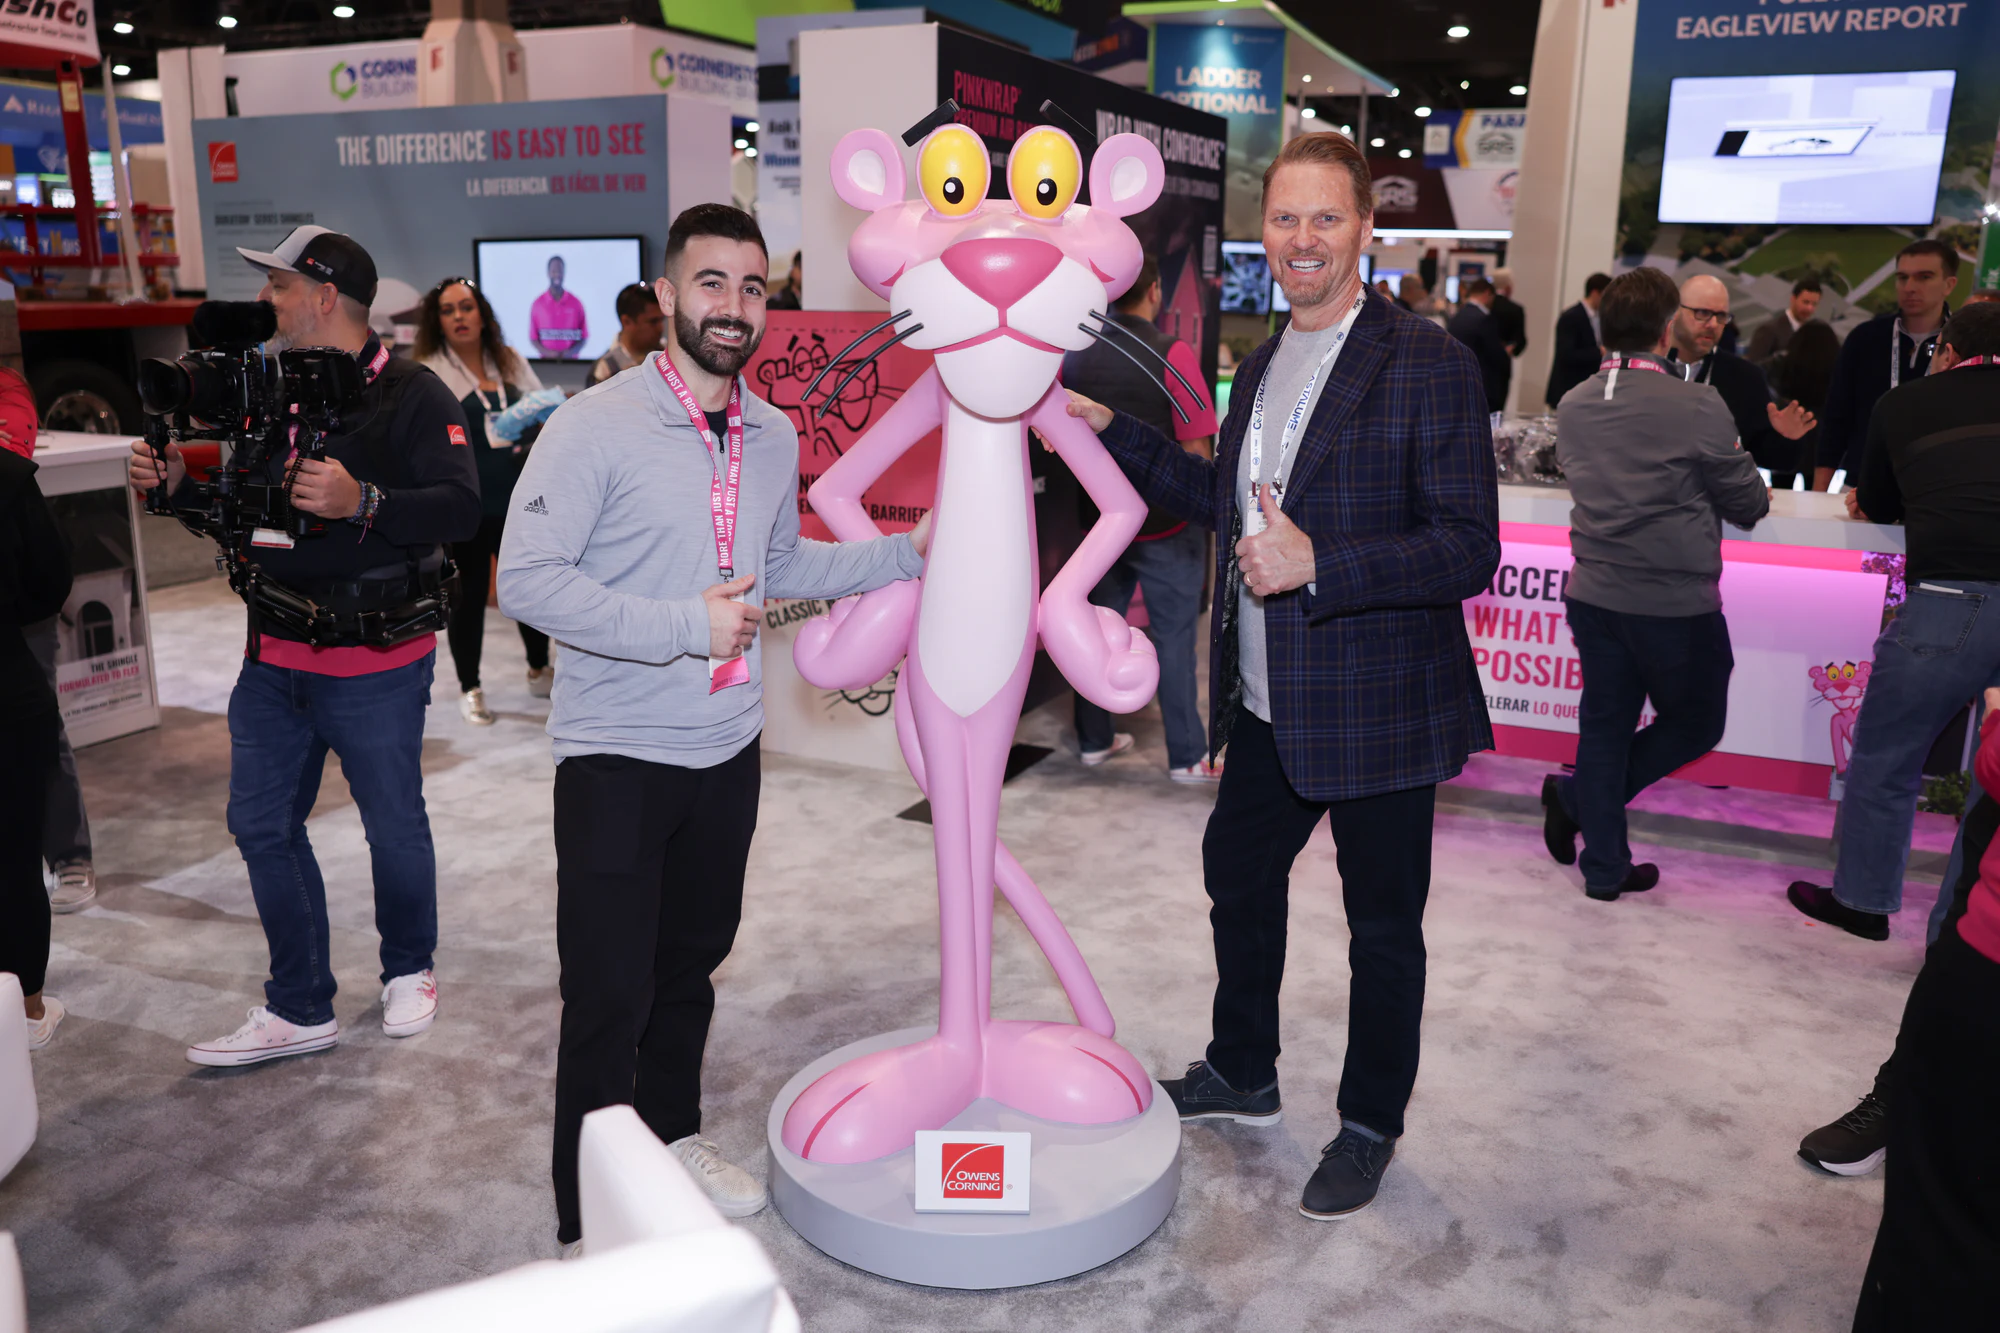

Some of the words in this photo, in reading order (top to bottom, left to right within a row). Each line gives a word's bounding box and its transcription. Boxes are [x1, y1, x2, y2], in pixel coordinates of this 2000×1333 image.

[0, 0, 87, 27] shCo
[1675, 10, 1840, 39] EAGLEVIEW
[1844, 3, 1967, 32] REPORT
[1176, 66, 1262, 89] LADDER
[336, 135, 371, 166] THE
[376, 130, 488, 165] DIFFERENCE
[492, 129, 512, 160] IS
[518, 126, 567, 160] EASY
[573, 124, 600, 157] TO
[608, 122, 647, 156] SEE
[466, 178, 481, 197] LA
[483, 176, 550, 196] DIFERENCIA
[657, 352, 671, 372] THAN
[665, 370, 684, 391] JUST
[677, 390, 688, 399] A
[731, 433, 741, 459] MORE
[728, 461, 740, 485] THAN
[713, 482, 721, 490] A
[726, 485, 737, 508] JUST
[523, 505, 549, 516] adidas
[712, 491, 723, 512] JUST
[724, 508, 735, 516] A
[714, 514, 726, 539] THAN
[718, 541, 729, 567] MORE
[766, 600, 822, 629] CLASSIC
[1533, 701, 1549, 715] LO
[946, 1181, 1000, 1191] CORNING
[956, 1170, 1000, 1181] OWENS
